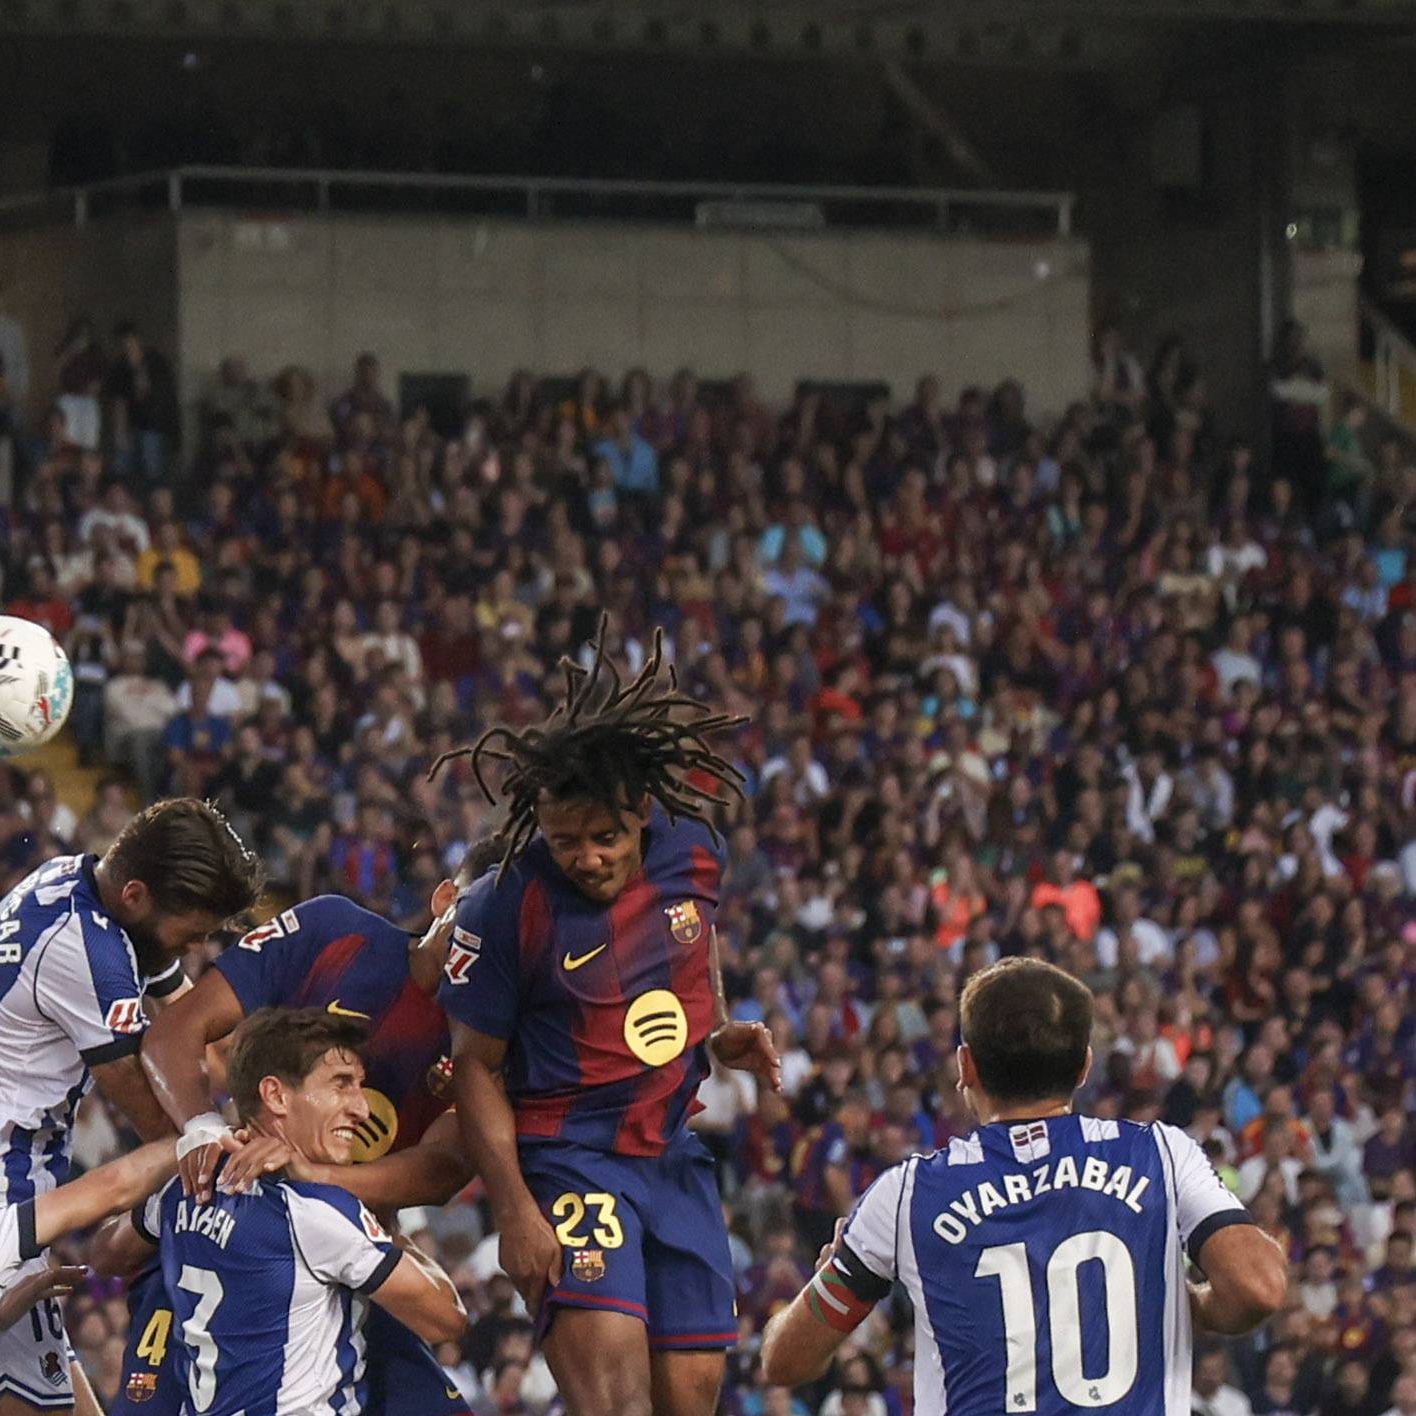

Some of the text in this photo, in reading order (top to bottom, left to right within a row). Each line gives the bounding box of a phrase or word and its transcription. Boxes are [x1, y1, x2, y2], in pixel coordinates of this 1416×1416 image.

[552, 1192, 624, 1248] 23
[933, 1156, 1149, 1245] OYARZABAL
[136, 1309, 173, 1367] 4
[177, 1264, 223, 1413] 3
[974, 1230, 1138, 1413] 10
